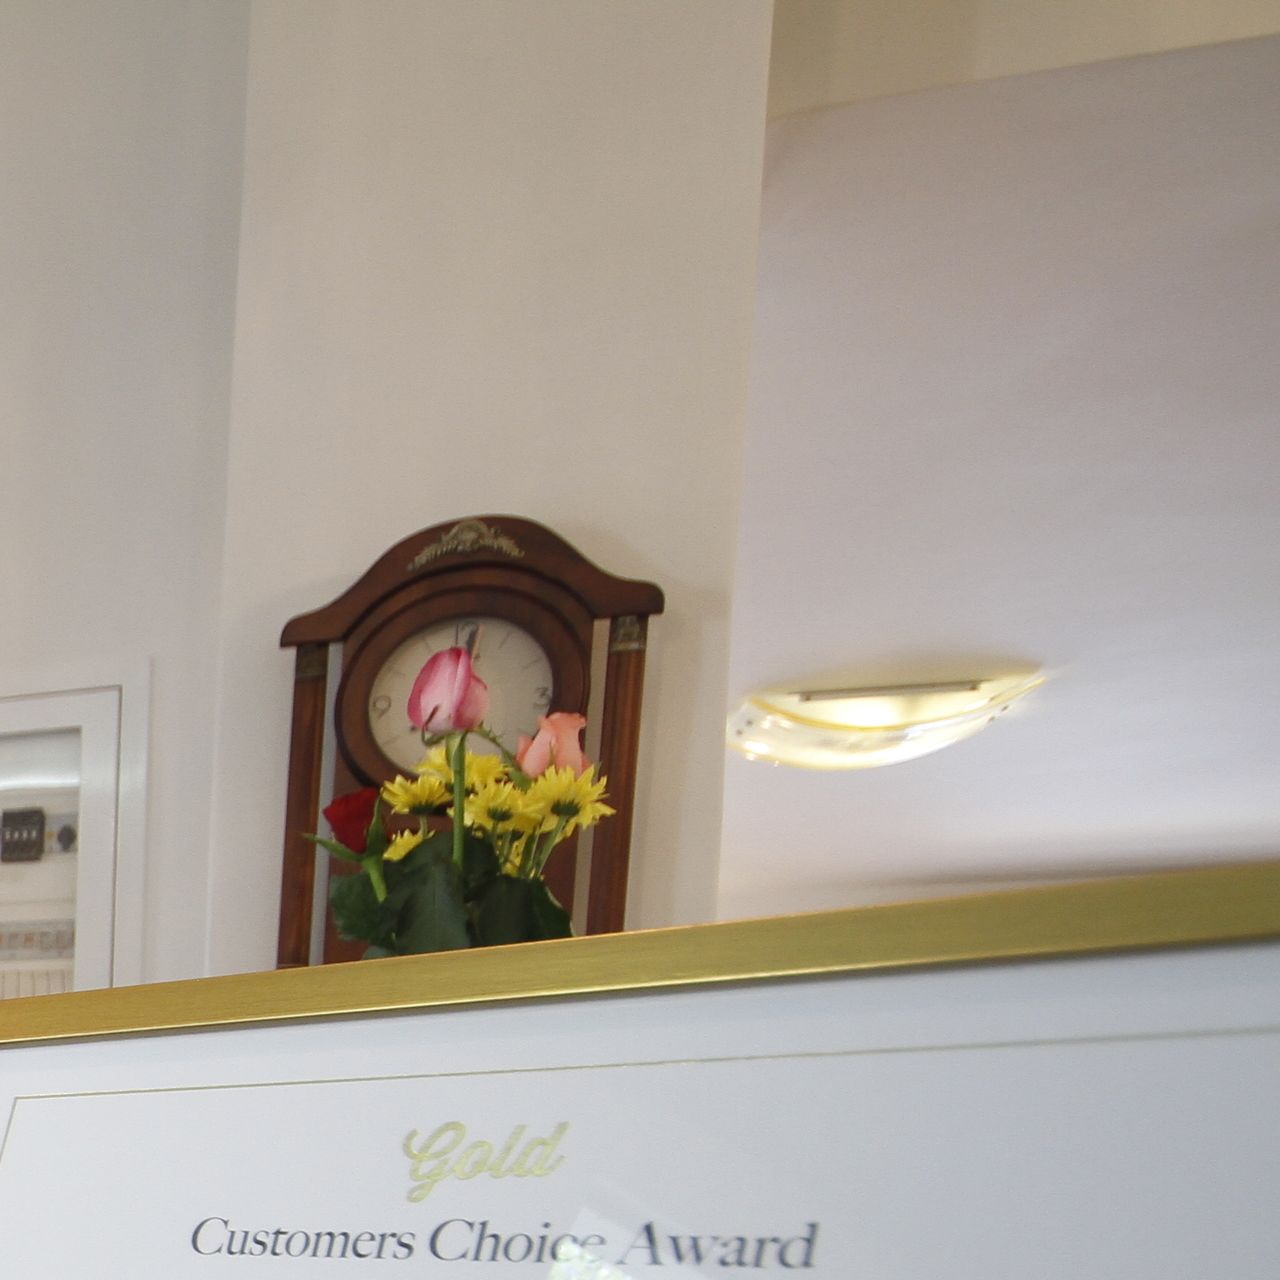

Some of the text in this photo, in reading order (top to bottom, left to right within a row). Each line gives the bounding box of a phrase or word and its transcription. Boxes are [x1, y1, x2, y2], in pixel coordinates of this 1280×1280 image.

[402, 1121, 570, 1202] Gold
[190, 1216, 822, 1271] Customers Choice Award
